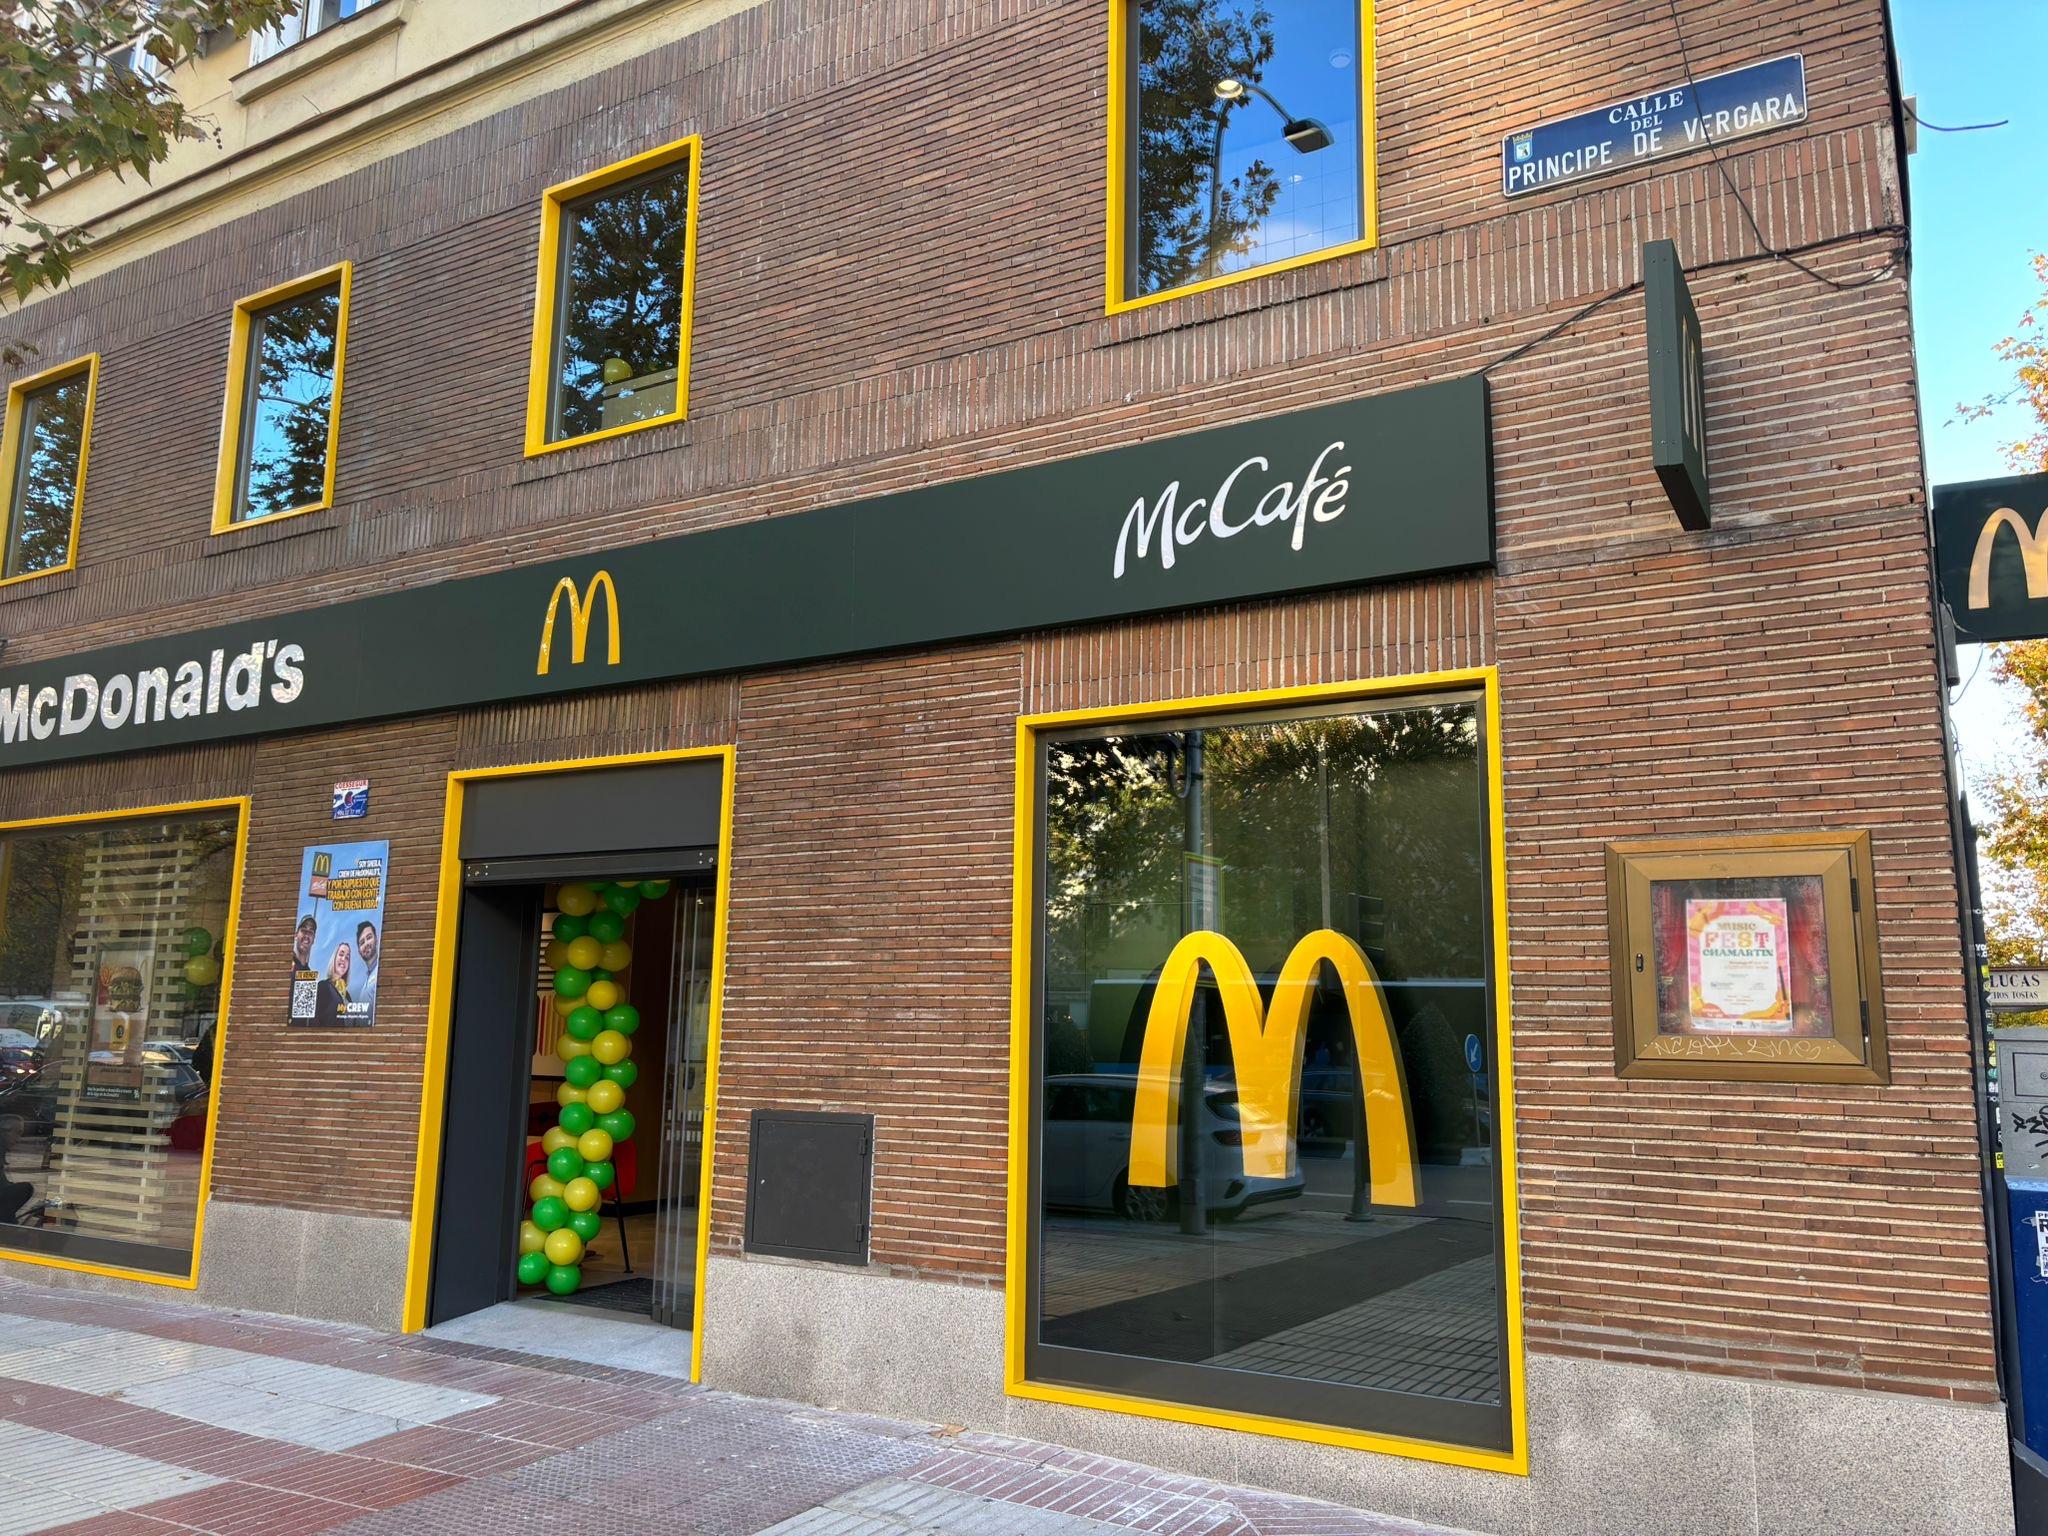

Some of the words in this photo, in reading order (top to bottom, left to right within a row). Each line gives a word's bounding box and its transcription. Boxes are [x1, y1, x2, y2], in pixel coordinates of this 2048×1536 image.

[1608, 91, 1683, 125] CALLE
[1630, 115, 1663, 133] DEL
[1508, 141, 1613, 190] PRINCIPE
[1633, 128, 1663, 157] DE
[1683, 93, 1798, 143] VERGARA
[1113, 441, 1352, 579] McCafé
[0, 639, 305, 745] McDonald's
[331, 880, 343, 889] POR
[343, 877, 369, 889] SUPUESTO
[370, 876, 380, 888] QUE
[327, 889, 350, 900] TRABAJO
[351, 889, 363, 899] CON
[363, 888, 379, 899] GENTE
[333, 900, 344, 910] CON
[345, 900, 362, 910] BUENA
[1717, 922, 1757, 931] MUSIC
[1704, 931, 1769, 949] FEST
[1990, 973, 2040, 988] LUCAS
